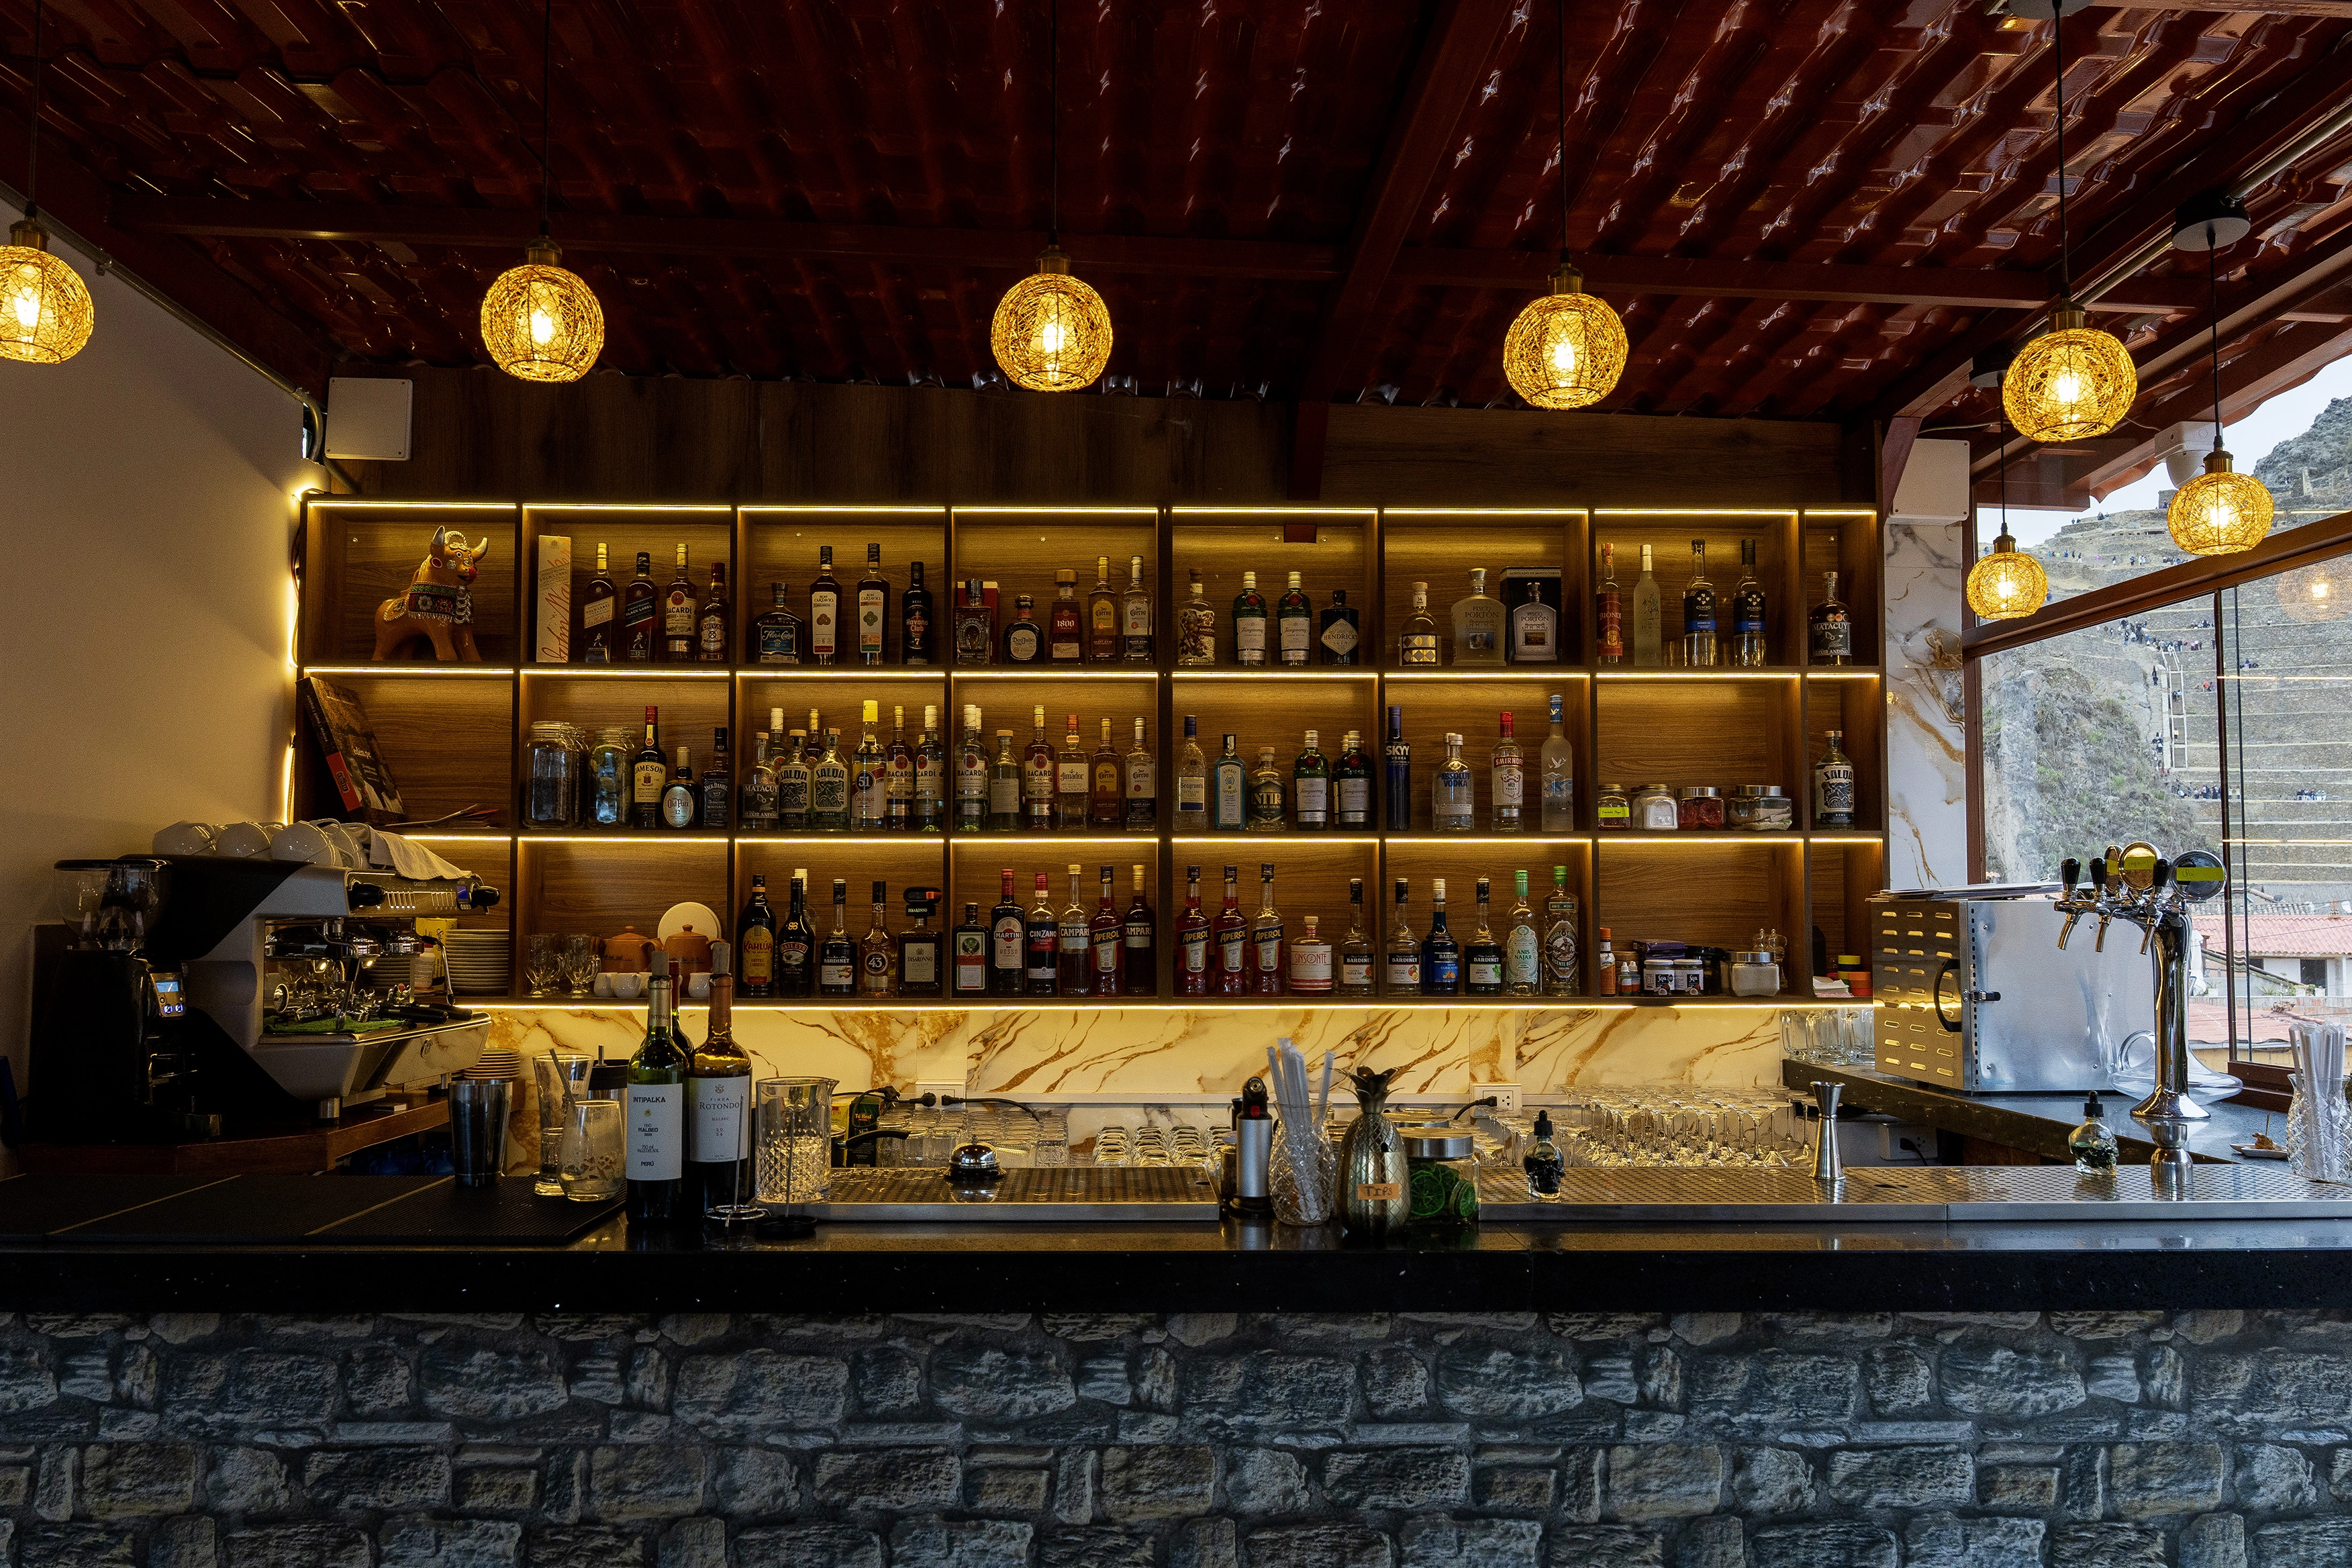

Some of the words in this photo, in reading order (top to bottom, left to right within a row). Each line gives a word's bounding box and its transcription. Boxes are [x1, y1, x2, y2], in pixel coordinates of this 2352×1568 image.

[1385, 745, 1410, 756] SKYY
[635, 765, 664, 774] JAMESON
[916, 769, 936, 777] CARDÍ
[957, 768, 983, 777] BACARDÍ
[1098, 772, 1115, 780] Cuervo
[1441, 772, 1470, 781] ABSOLUT
[858, 775, 871, 787] 51
[1443, 779, 1468, 787] VODKA
[703, 784, 714, 792] JACK
[667, 799, 677, 809] Old
[1029, 929, 1057, 938] CINZANO
[1061, 928, 1090, 937] CAMPARI
[1124, 927, 1152, 935] AMPARI
[1255, 929, 1281, 942] APEROL
[1093, 930, 1120, 944] APEROL
[1182, 930, 1208, 944] APEROL
[1220, 930, 1246, 943] APEROL
[743, 940, 772, 953] KAHLÚA
[781, 943, 806, 952] BAILEYS
[868, 957, 883, 968] 43
[1294, 953, 1327, 964] SINSONTE
[699, 1101, 740, 1110] ROTONDO
[1363, 1185, 1393, 1197] TIPS
